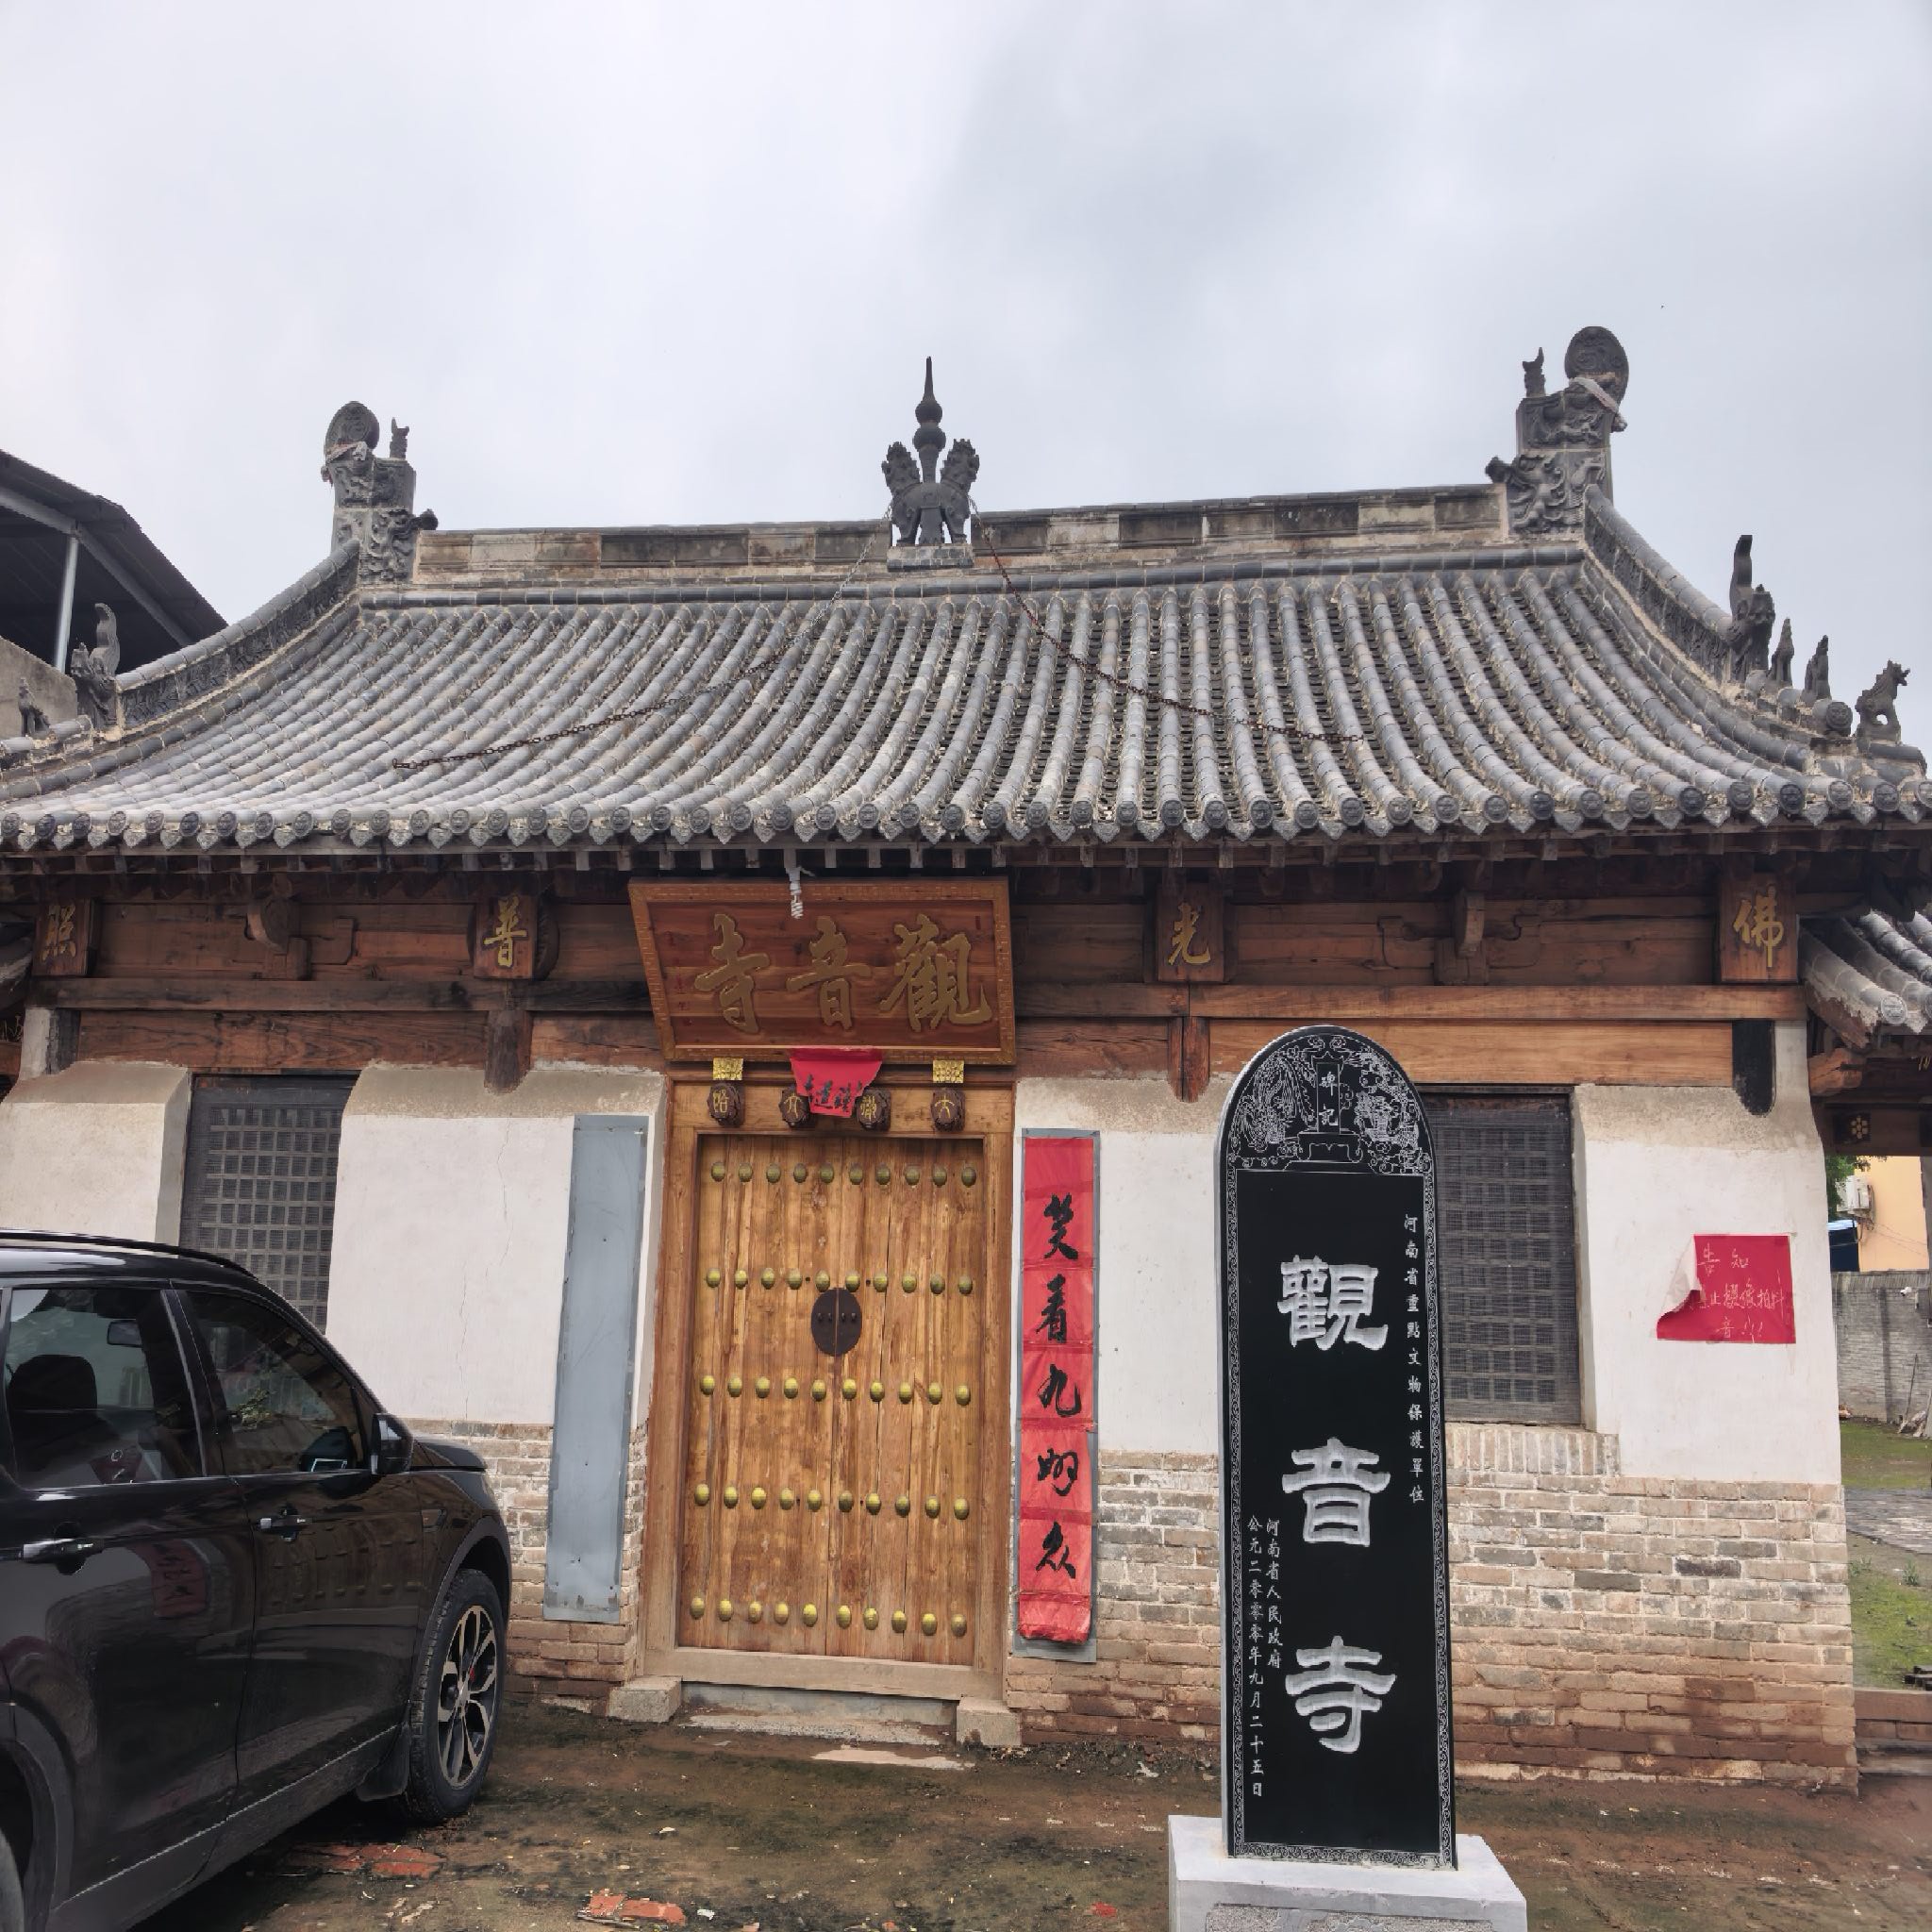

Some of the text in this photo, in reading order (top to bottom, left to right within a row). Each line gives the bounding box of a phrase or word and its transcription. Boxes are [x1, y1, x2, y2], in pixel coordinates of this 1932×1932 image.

[42, 903, 77, 962] 照
[483, 894, 527, 968] 普
[693, 913, 994, 1034] 觀音寺
[1168, 901, 1212, 967] 光
[1733, 887, 1785, 968] 佛
[1276, 1254, 1397, 1755] 觀音寺
[1265, 1516, 1283, 1670] 河南省人民政府
[1247, 1514, 1264, 1798] 公元二零零零年九月二十五日
